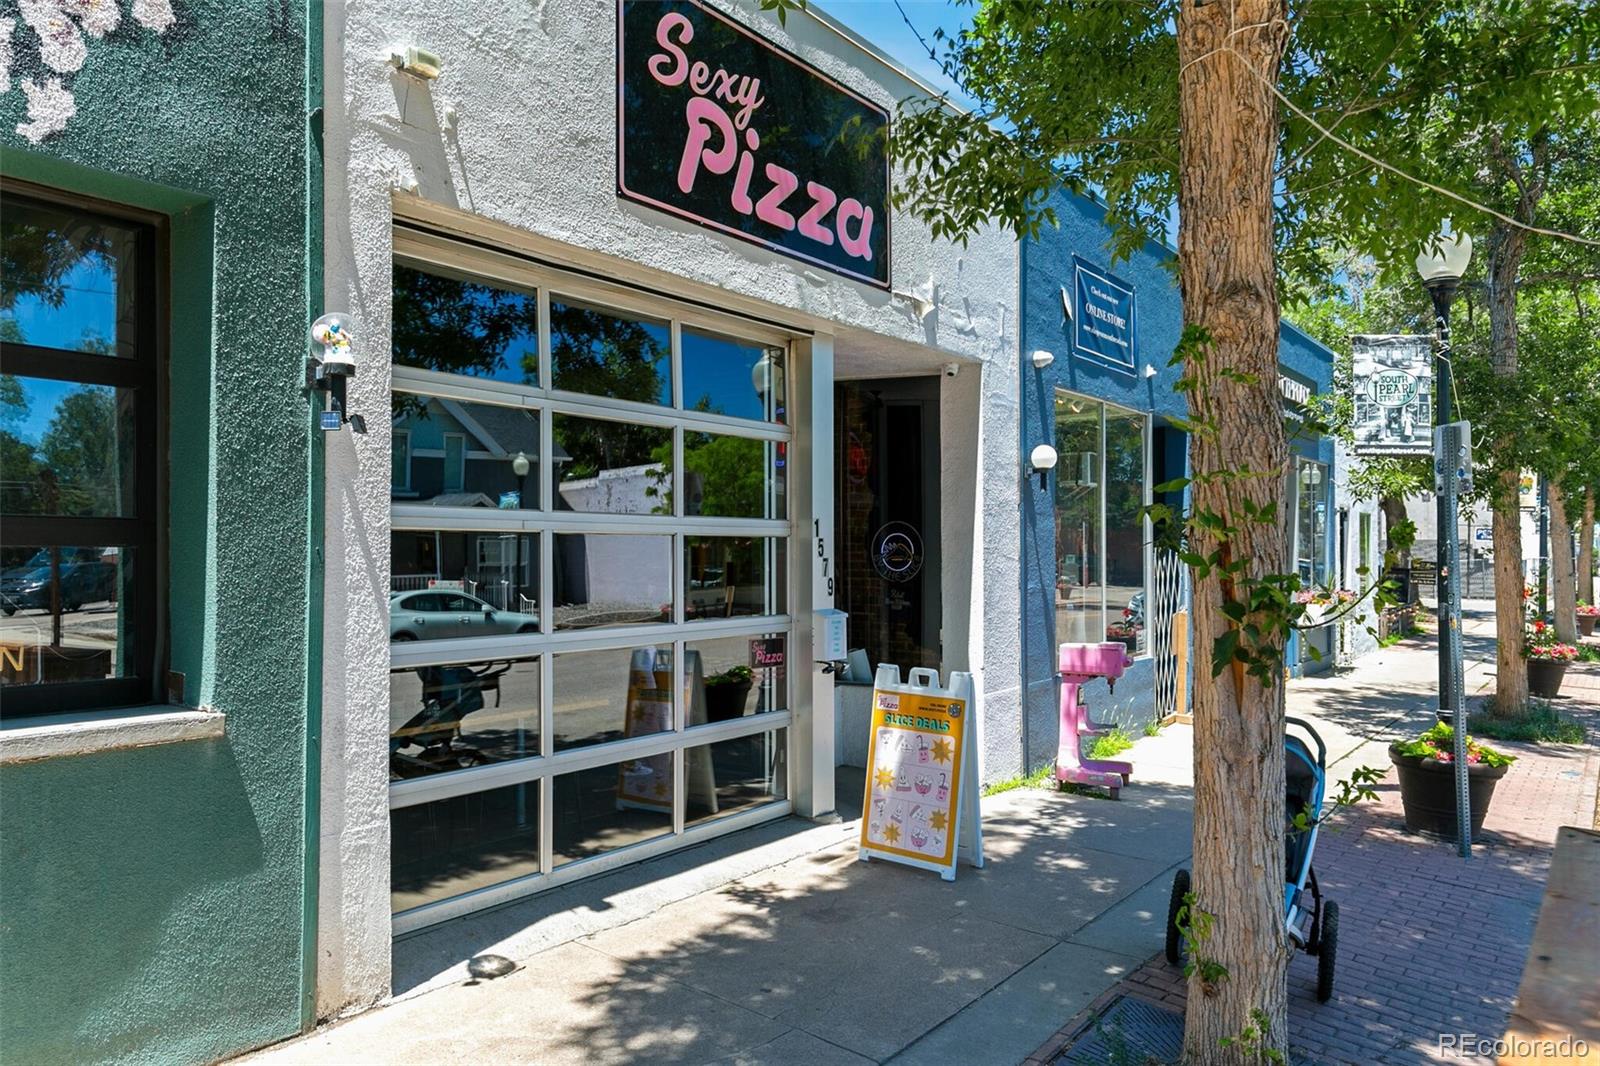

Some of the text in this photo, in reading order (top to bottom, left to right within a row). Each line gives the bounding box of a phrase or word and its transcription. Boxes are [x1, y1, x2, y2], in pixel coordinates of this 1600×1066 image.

[648, 12, 765, 131] Sexy
[677, 97, 874, 261] Pizza
[1380, 375, 1408, 383] SOUTH
[1379, 383, 1414, 398] PEARL
[814, 518, 834, 596] 1579
[755, 650, 784, 664] Pizza
[884, 712, 951, 732] SLICE DEALS
